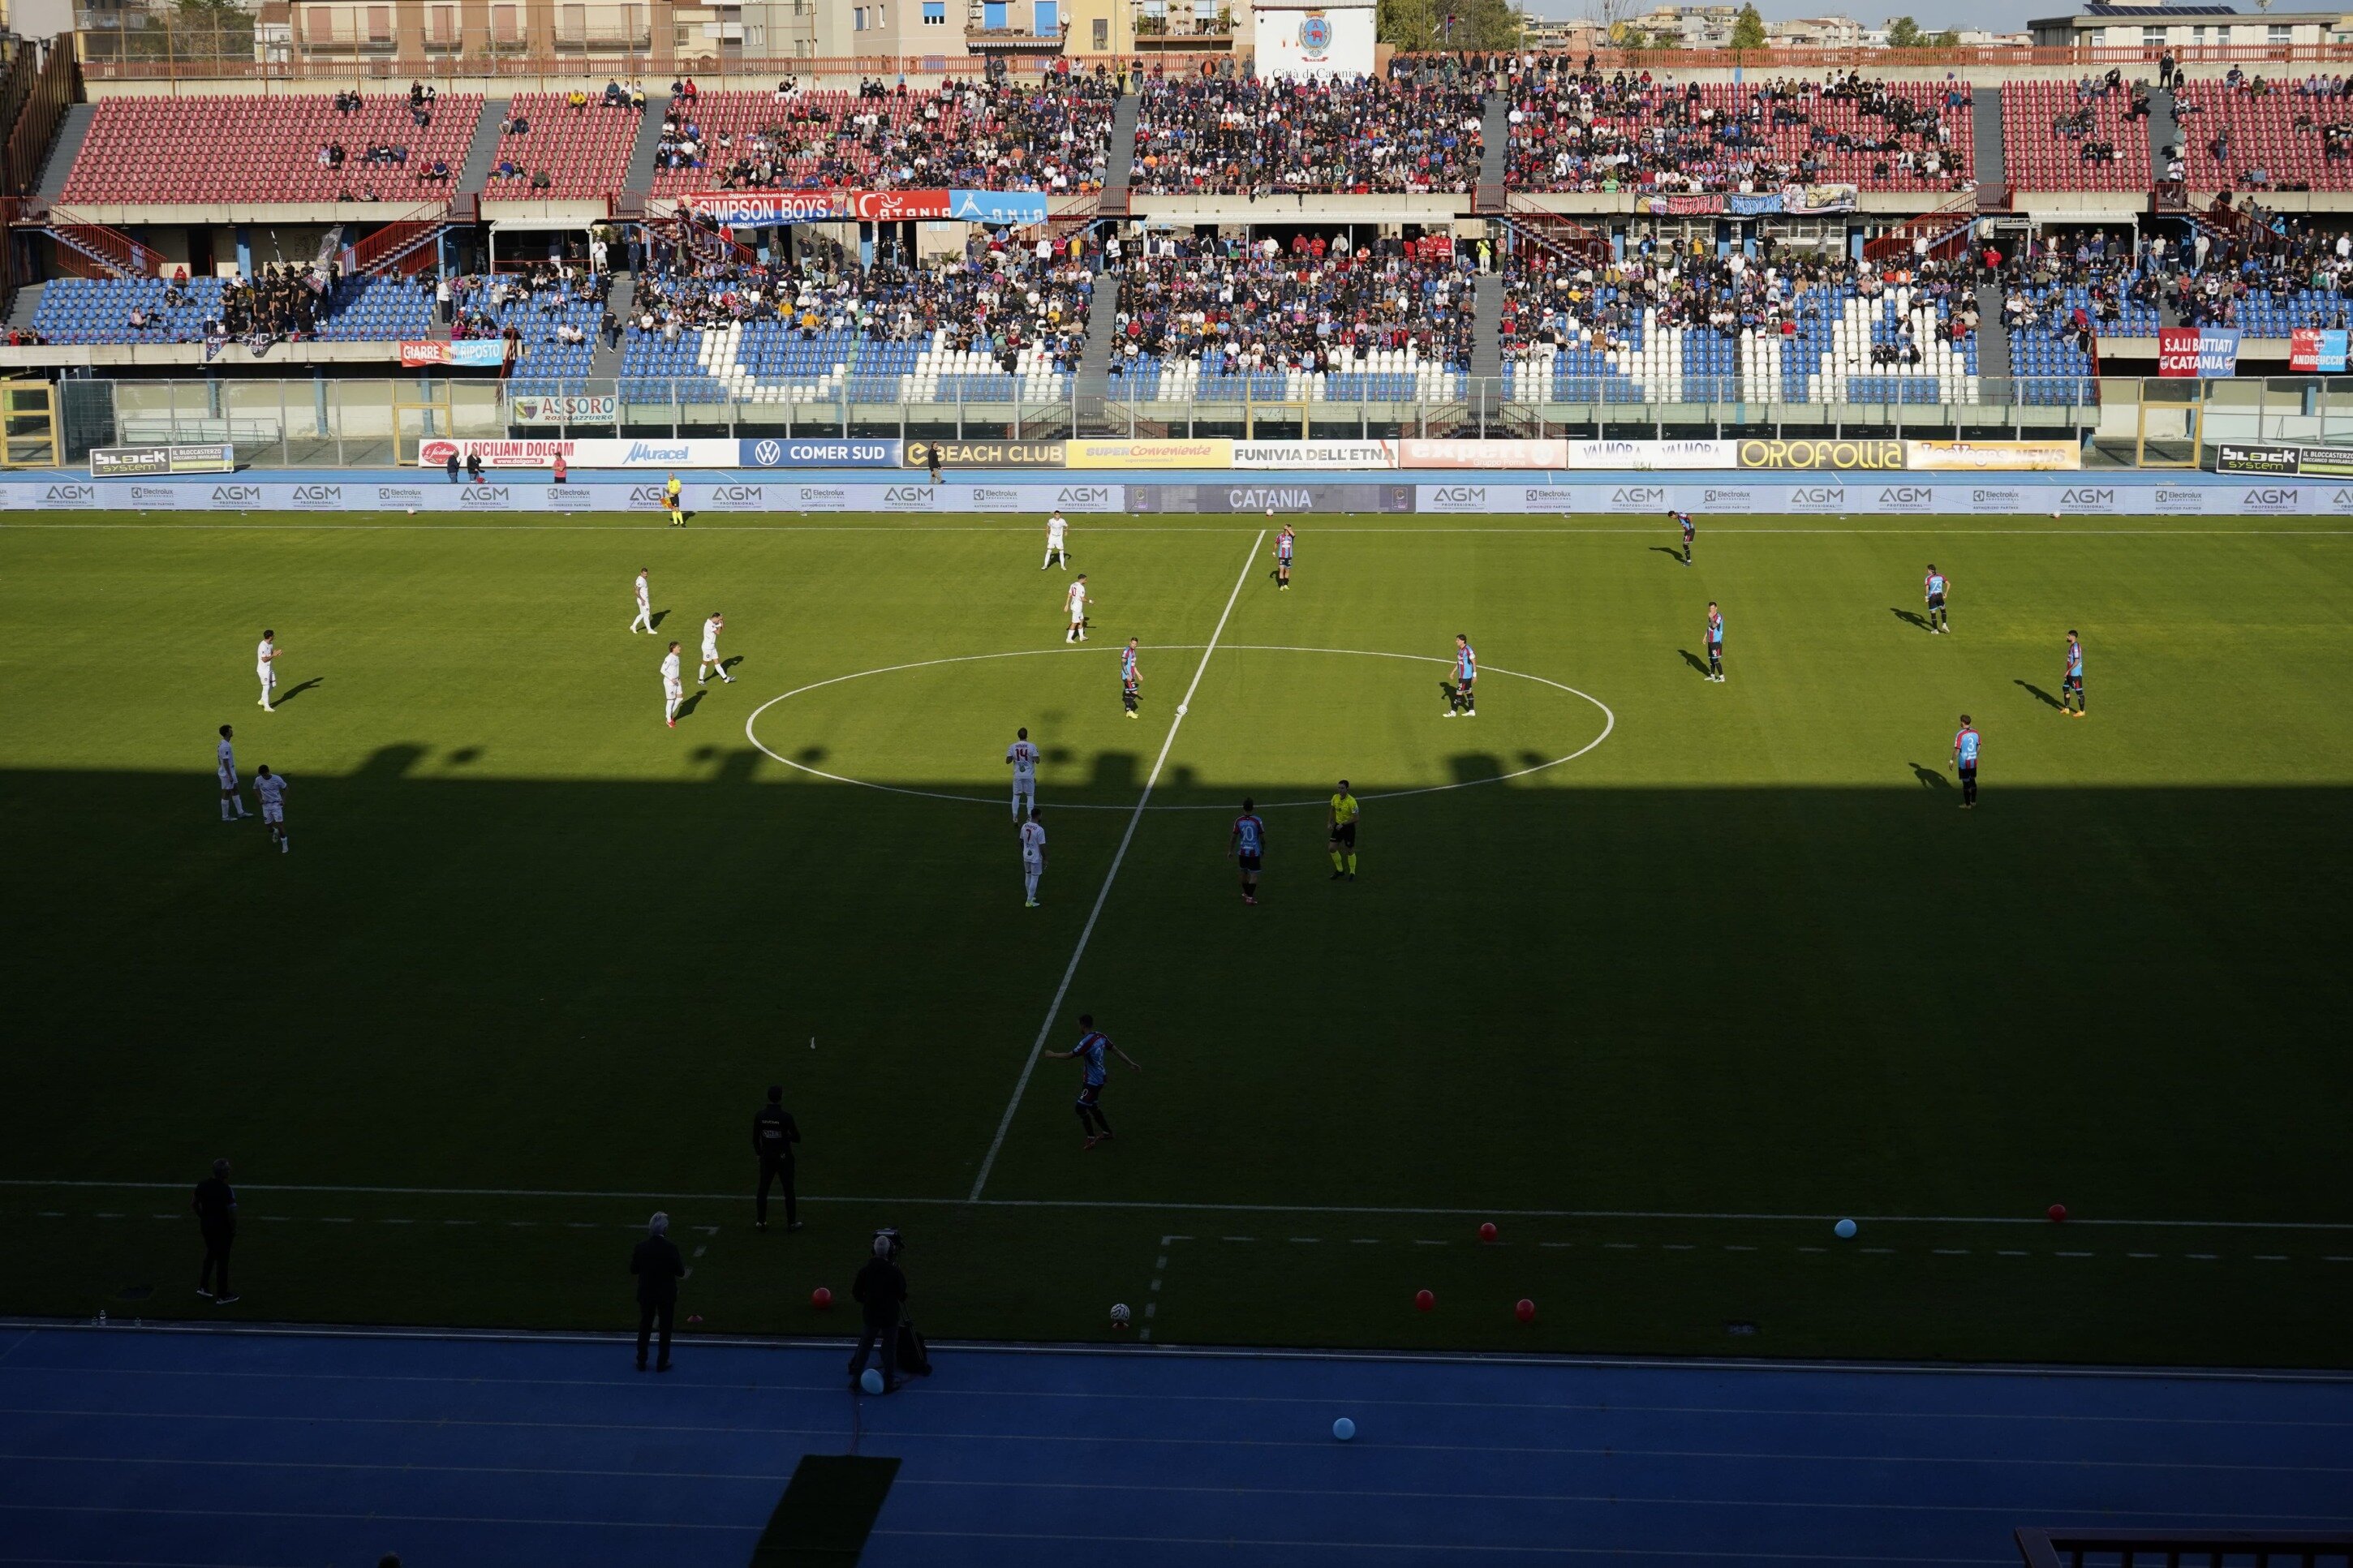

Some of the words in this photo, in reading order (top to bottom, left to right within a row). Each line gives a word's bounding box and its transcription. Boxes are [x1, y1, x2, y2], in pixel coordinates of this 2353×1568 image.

[699, 199, 775, 221] SIMPSON
[781, 197, 827, 219] BOYS
[1669, 195, 1723, 214] ORGOGLIO
[1731, 195, 1783, 215] PASSIONE
[403, 346, 439, 359] GIARRE
[460, 343, 500, 359] RIPOSTO
[2192, 338, 2233, 353] BATTIATI
[2170, 355, 2223, 370] CATANIA
[2292, 354, 2345, 365] ANDREUCCIO
[542, 397, 614, 415] ASSORO
[527, 442, 574, 456] DOLGAM
[622, 441, 689, 464] Muracel
[790, 446, 849, 460] COMER
[852, 446, 885, 460] SUD
[936, 445, 1002, 462] BEACH
[1009, 445, 1063, 462] CLUB
[1234, 449, 1302, 461] FUNIVIA
[1411, 441, 1526, 462] expert
[46, 486, 94, 499] AGM
[212, 487, 260, 500] AGM
[293, 487, 341, 500] AGM
[460, 487, 509, 500] AGM
[559, 488, 590, 496] Electrolux
[712, 487, 761, 500] AGM
[884, 488, 933, 501] AGM
[1057, 488, 1108, 501] AGM
[1229, 489, 1313, 508] CATANIA
[1434, 488, 1485, 501] AGM
[1611, 488, 1663, 502] AGM
[1792, 488, 1843, 502] AGM
[1878, 488, 1931, 502] AGM
[2061, 489, 2114, 503] AGM
[2243, 489, 2297, 504] AGM
[1015, 748, 1029, 762] 14
[1025, 828, 1032, 843] 7
[1241, 826, 1254, 841] 10
